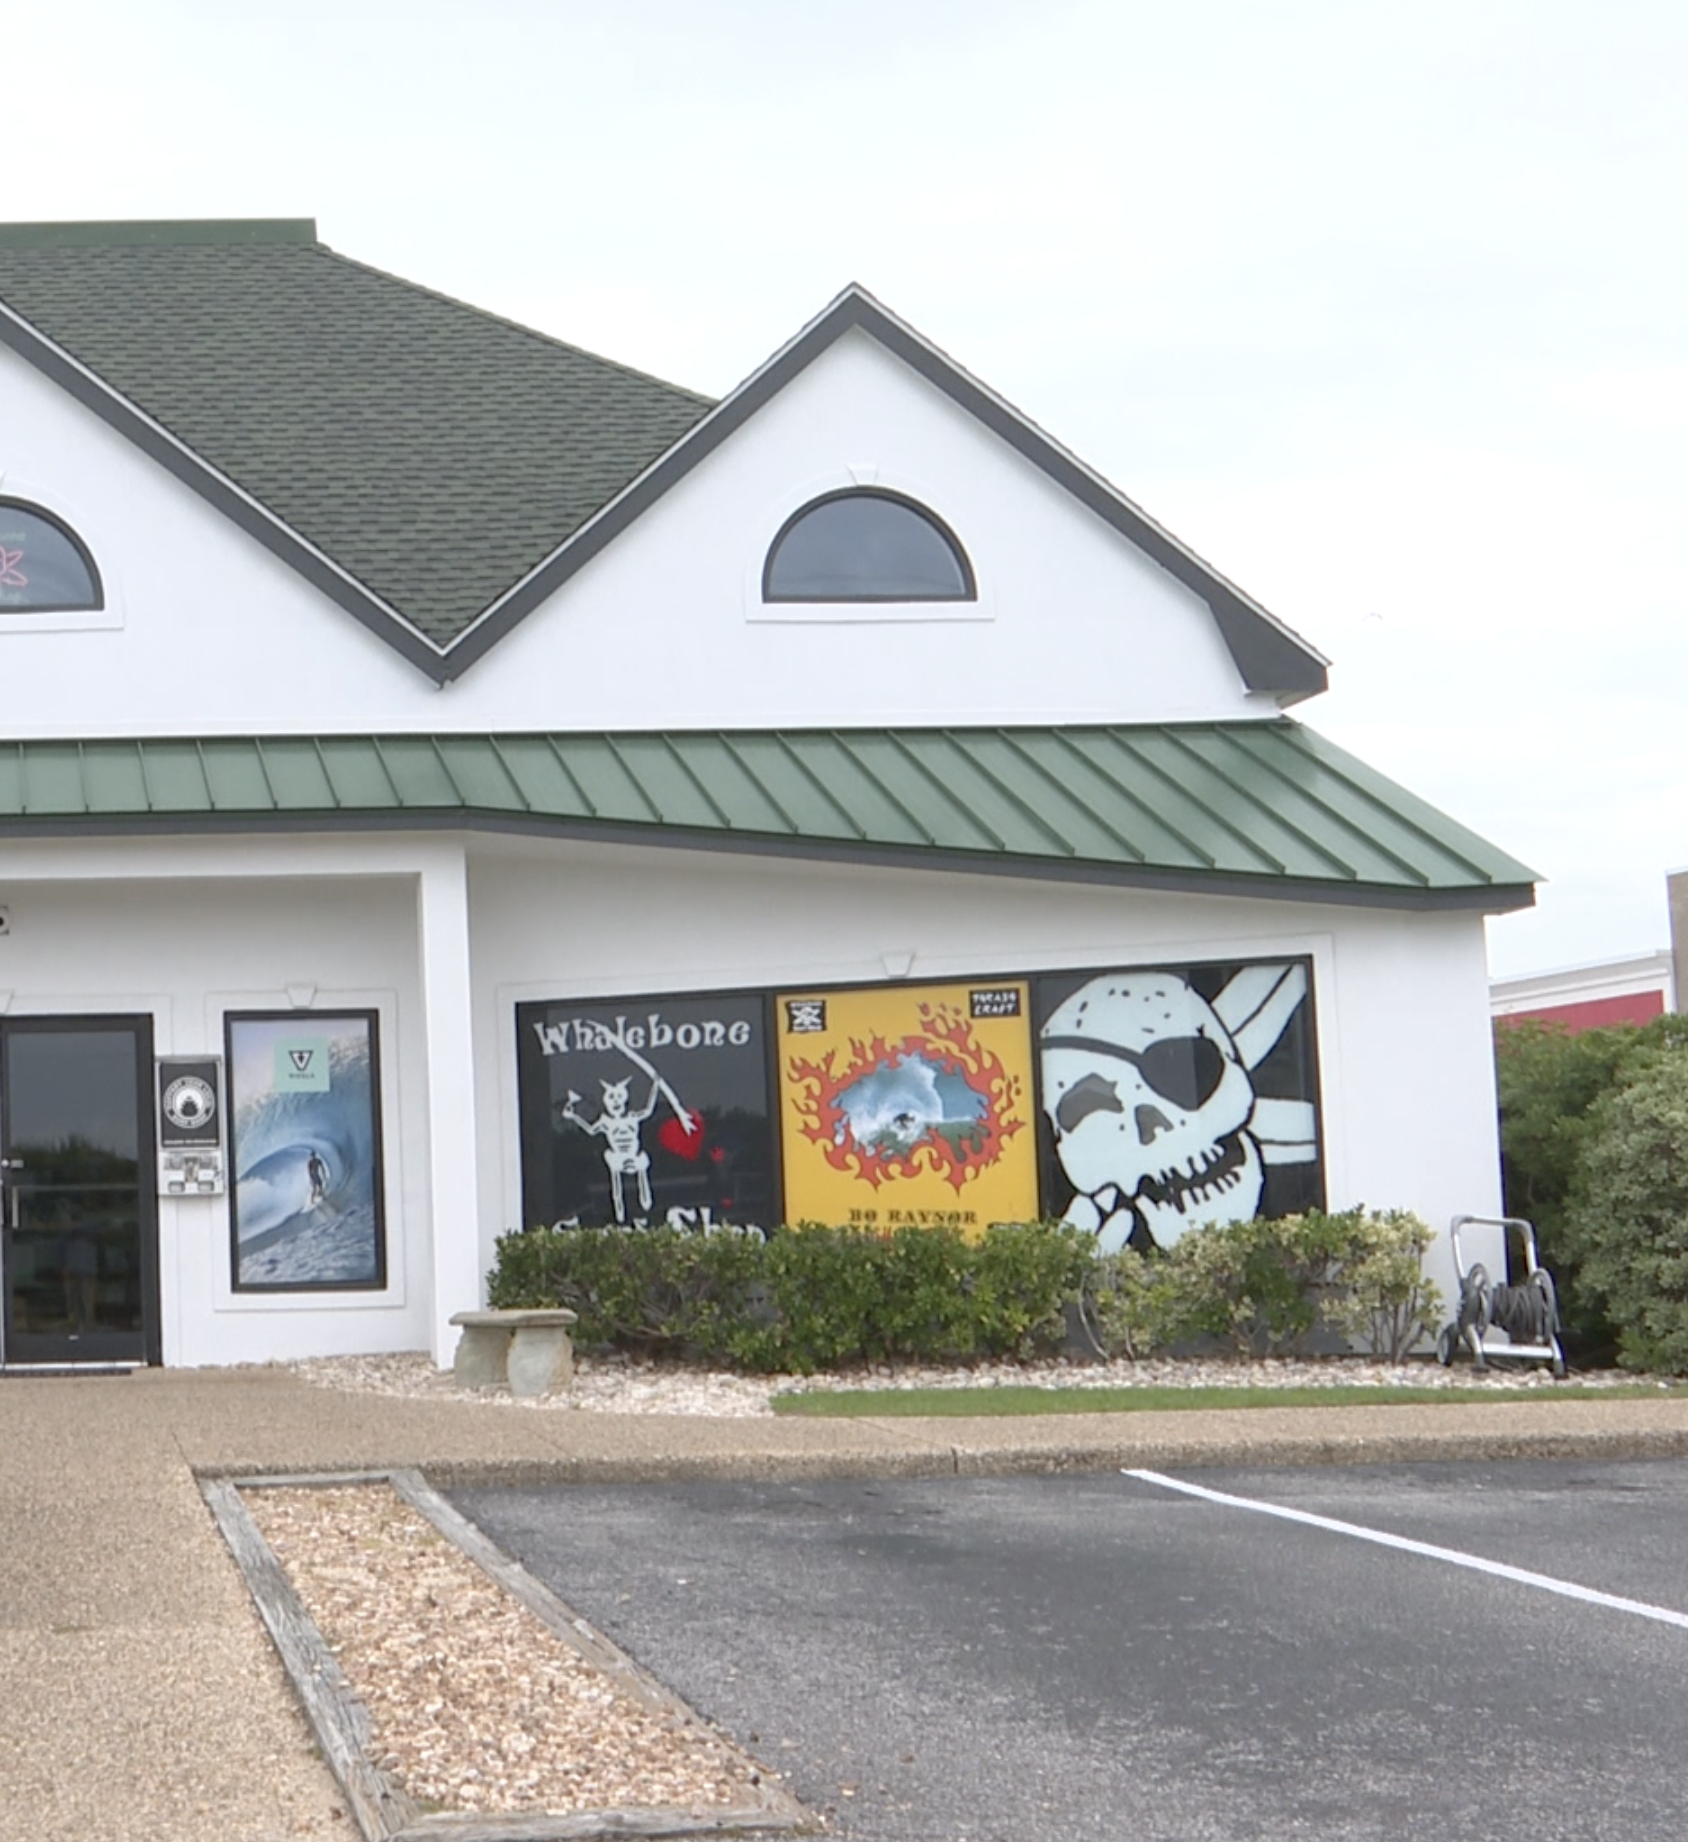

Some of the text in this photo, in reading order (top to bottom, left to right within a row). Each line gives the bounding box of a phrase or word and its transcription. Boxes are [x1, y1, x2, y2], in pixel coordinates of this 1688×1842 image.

[533, 1014, 750, 1056] Whalebone
[849, 1208, 978, 1225] BO RAYNOR
